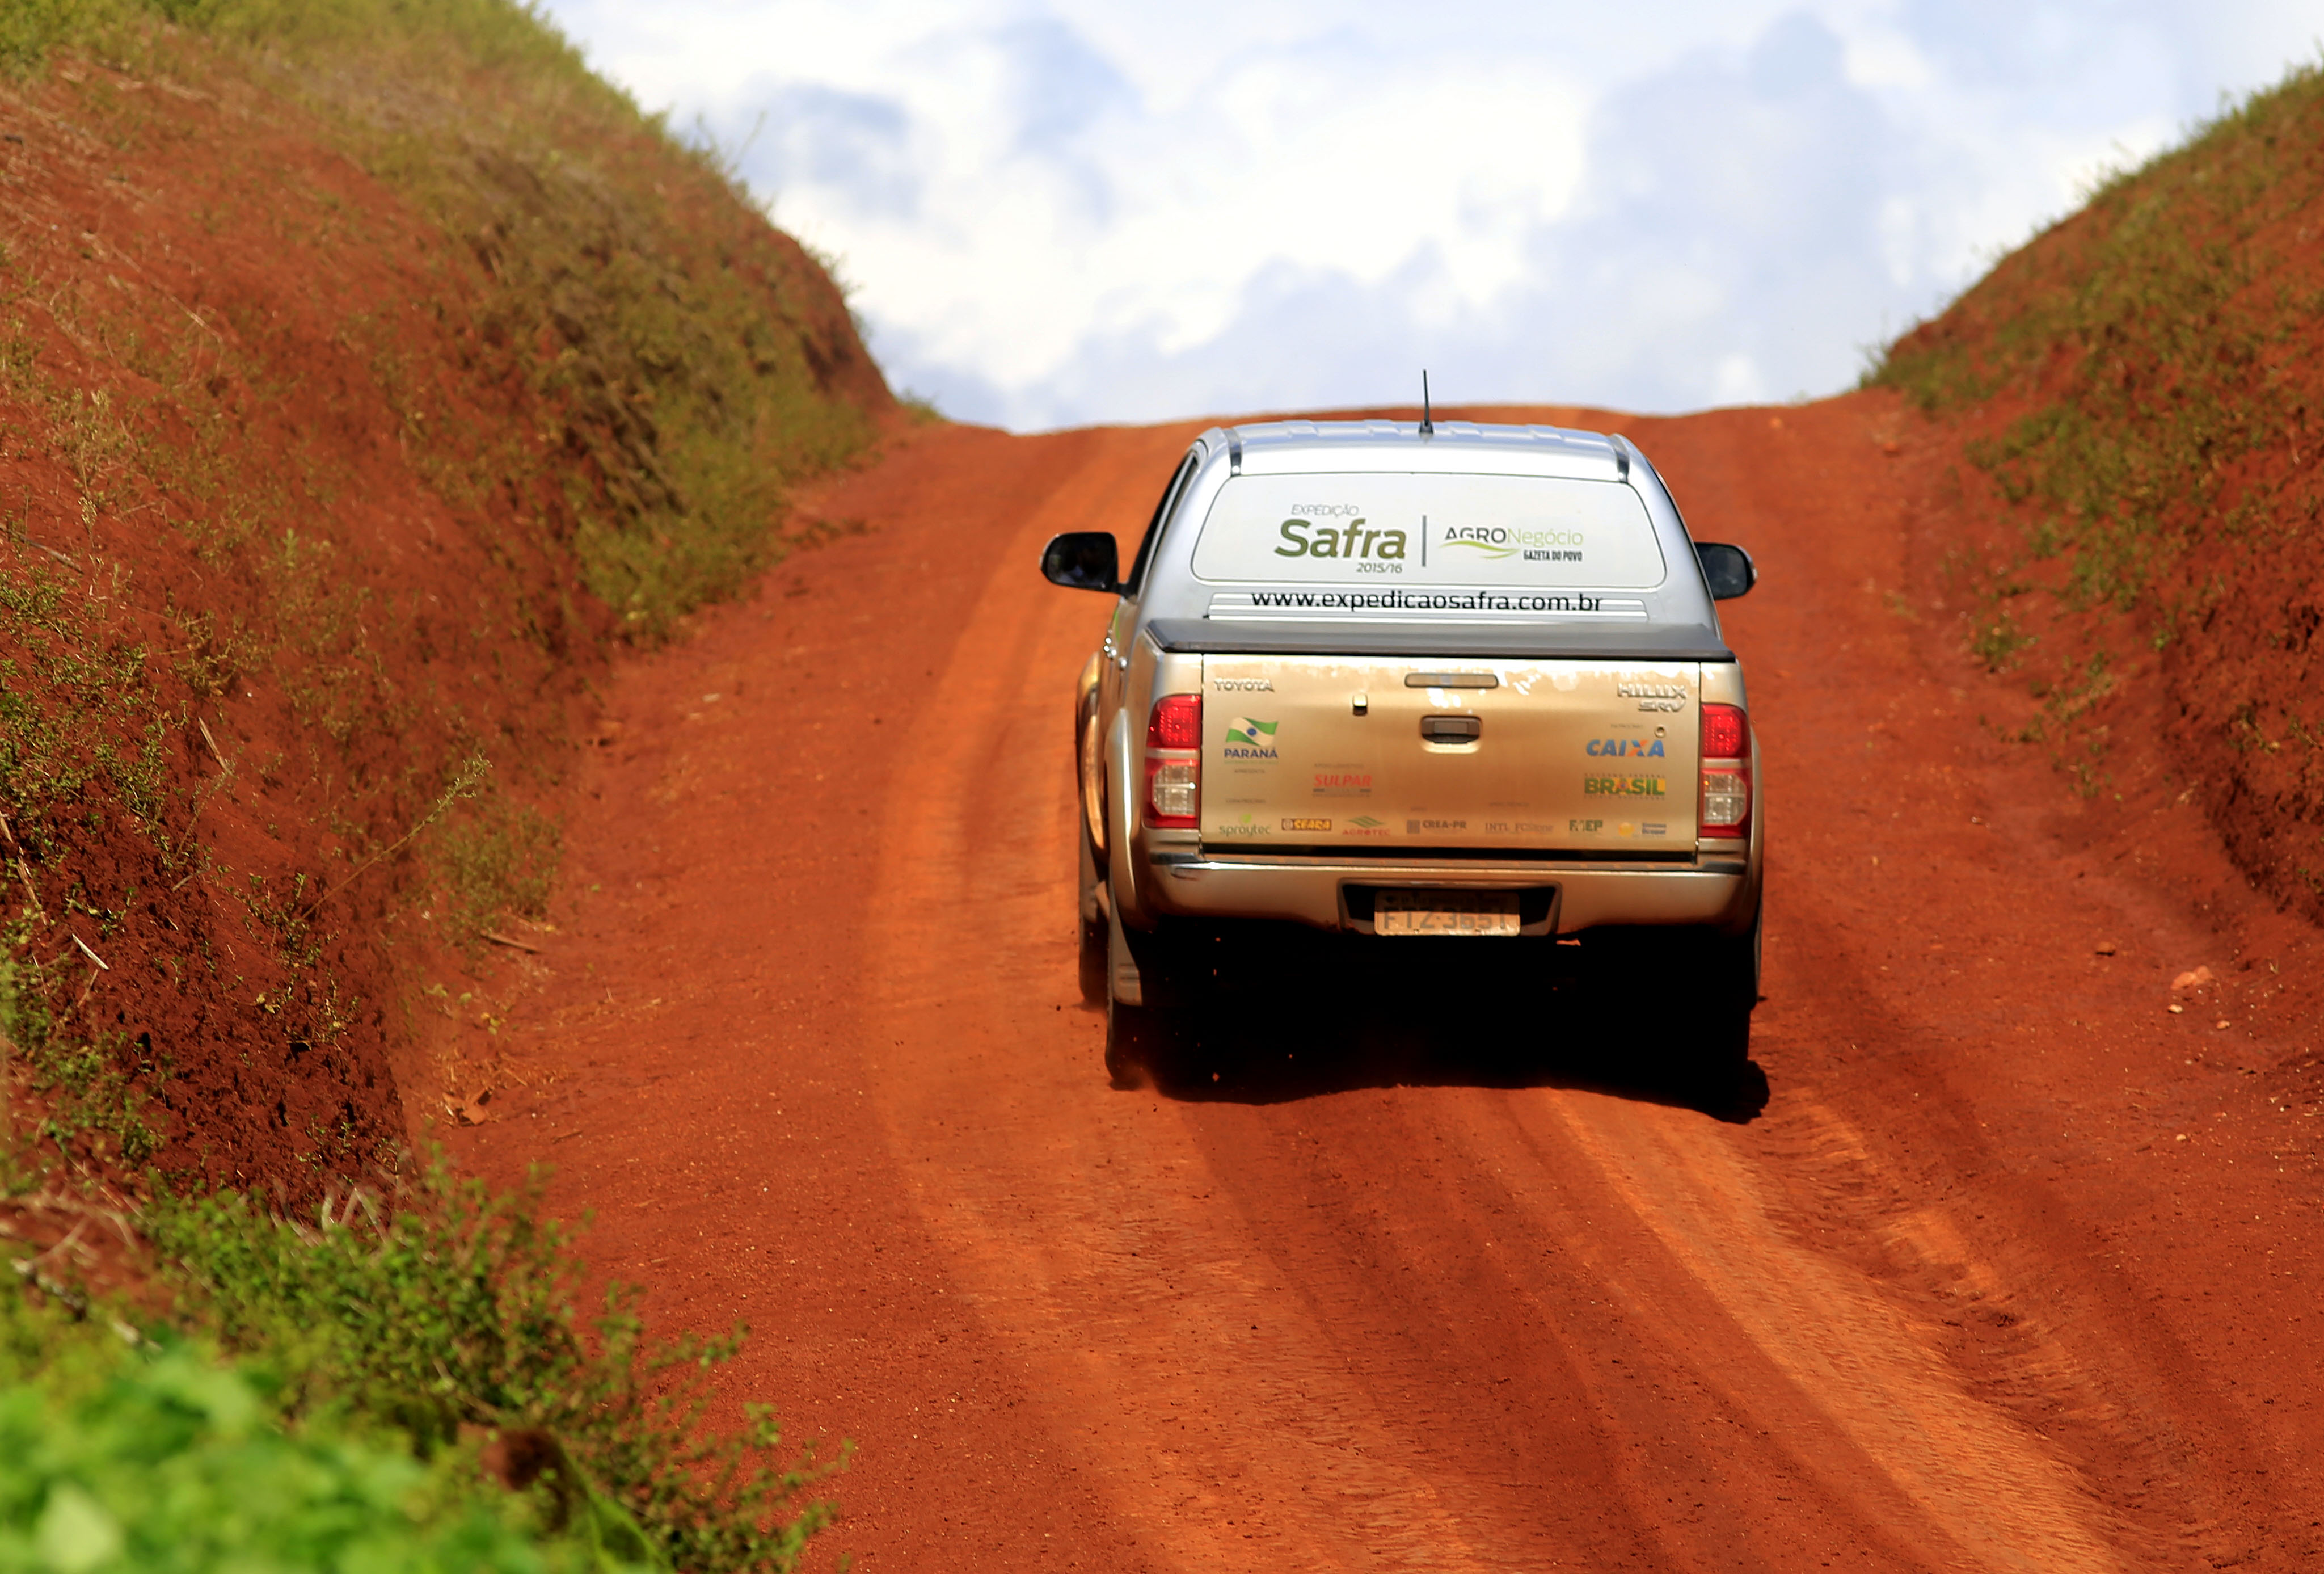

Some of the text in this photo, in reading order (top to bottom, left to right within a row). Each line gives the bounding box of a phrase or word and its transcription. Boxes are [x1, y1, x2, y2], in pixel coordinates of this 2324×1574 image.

[1291, 503, 1360, 517] EXPEDIÇÃO
[1274, 519, 1406, 559] Safra
[1445, 527, 1583, 548] AGRONegócio
[1524, 550, 1583, 561] GAZETA DO POVO
[1356, 562, 1403, 573] 2015/16
[1251, 590, 1602, 612] www.expedicaosafra.com.br
[1213, 678, 1275, 693] TOYOTA
[1618, 683, 1687, 700] HILUX
[1224, 747, 1279, 759] PARANÁ
[1586, 739, 1665, 757] CAIXA
[1314, 774, 1372, 788] SULPAR
[1584, 778, 1666, 795] BRASIL
[1218, 824, 1271, 837] spraytec
[1423, 820, 1467, 830] CREA-PR
